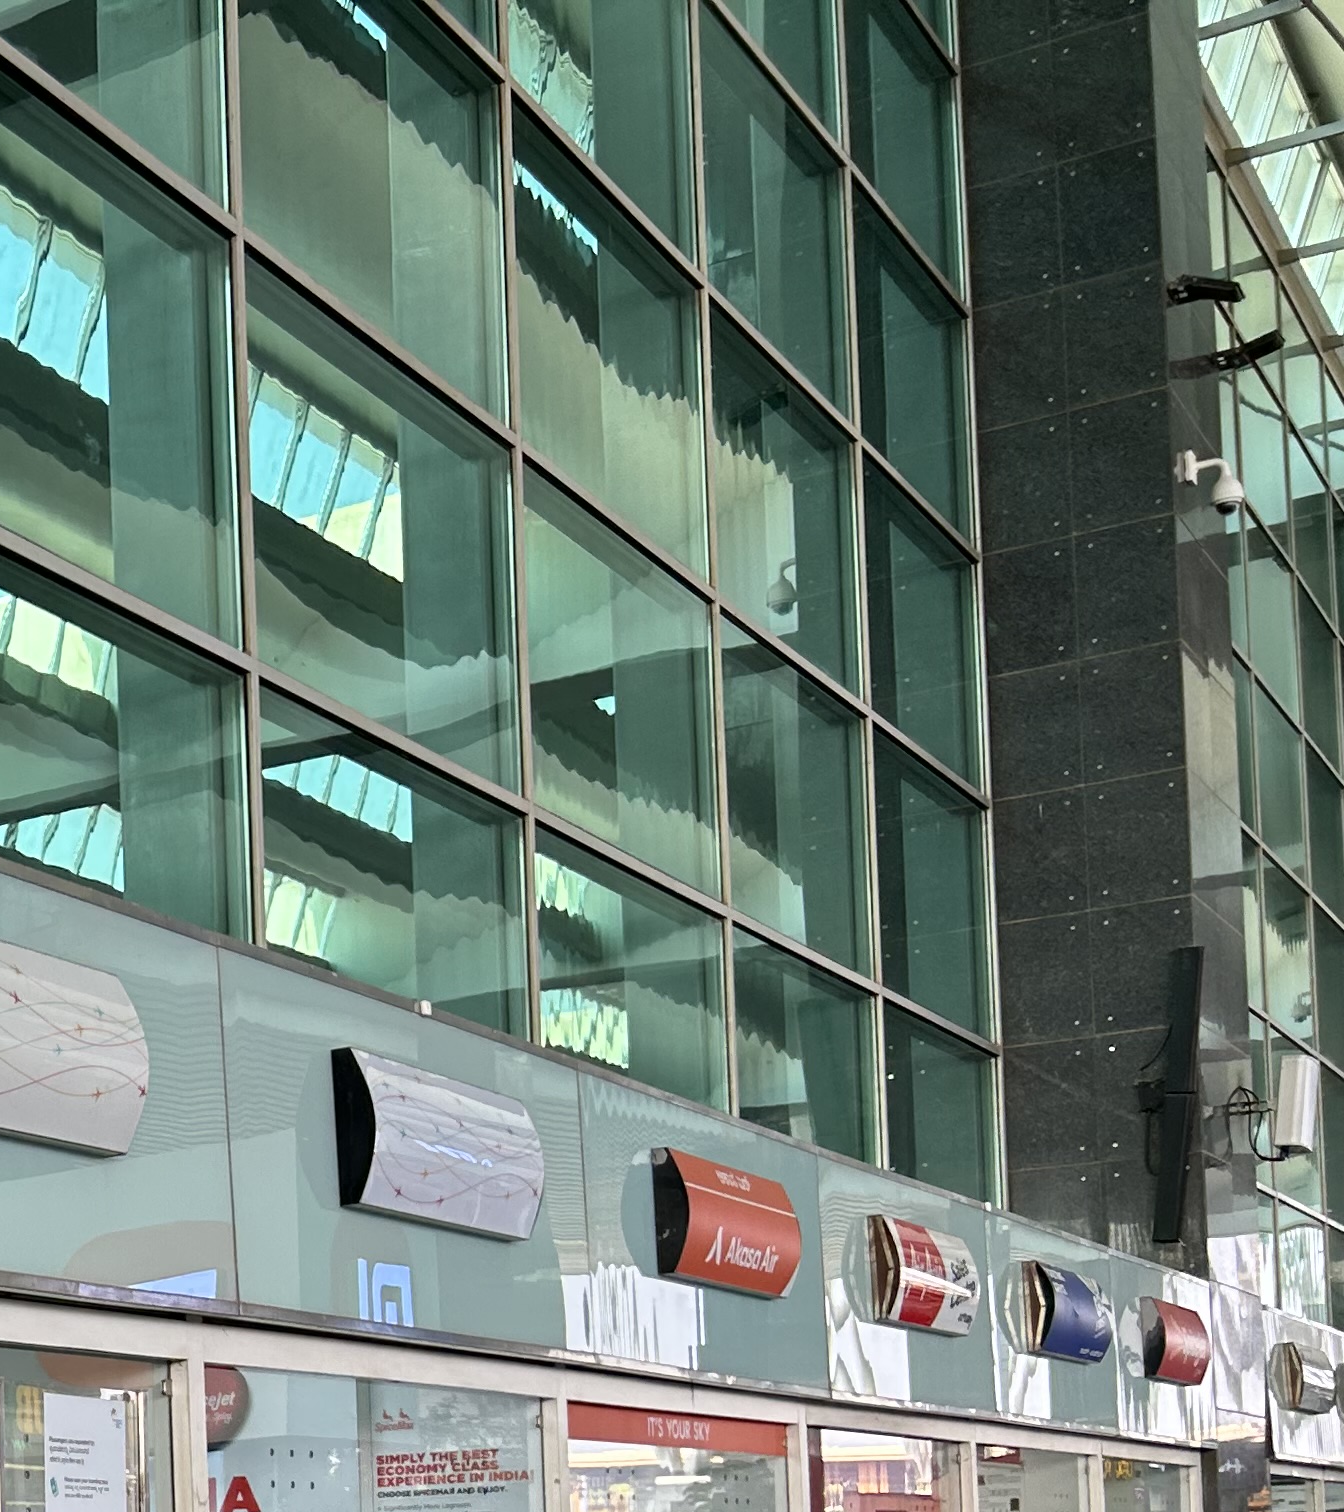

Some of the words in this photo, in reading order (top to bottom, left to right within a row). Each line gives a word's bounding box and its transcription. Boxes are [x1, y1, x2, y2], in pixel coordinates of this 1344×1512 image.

[724, 1236, 761, 1271] Akasa
[760, 1245, 780, 1274] Air
[647, 1416, 664, 1438] IT'S
[666, 1418, 691, 1440] YOUR
[694, 1422, 710, 1442] SKY
[376, 1452, 426, 1466] SIMPLY
[430, 1450, 459, 1462] THE
[462, 1449, 499, 1461] BEST
[377, 1463, 447, 1476] ECONOMY
[452, 1460, 500, 1472] CLASS
[377, 1473, 465, 1488] EXPERIENCE
[470, 1472, 485, 1482] IN
[377, 1489, 412, 1498] CHOOSE
[457, 1486, 475, 1495] AND
